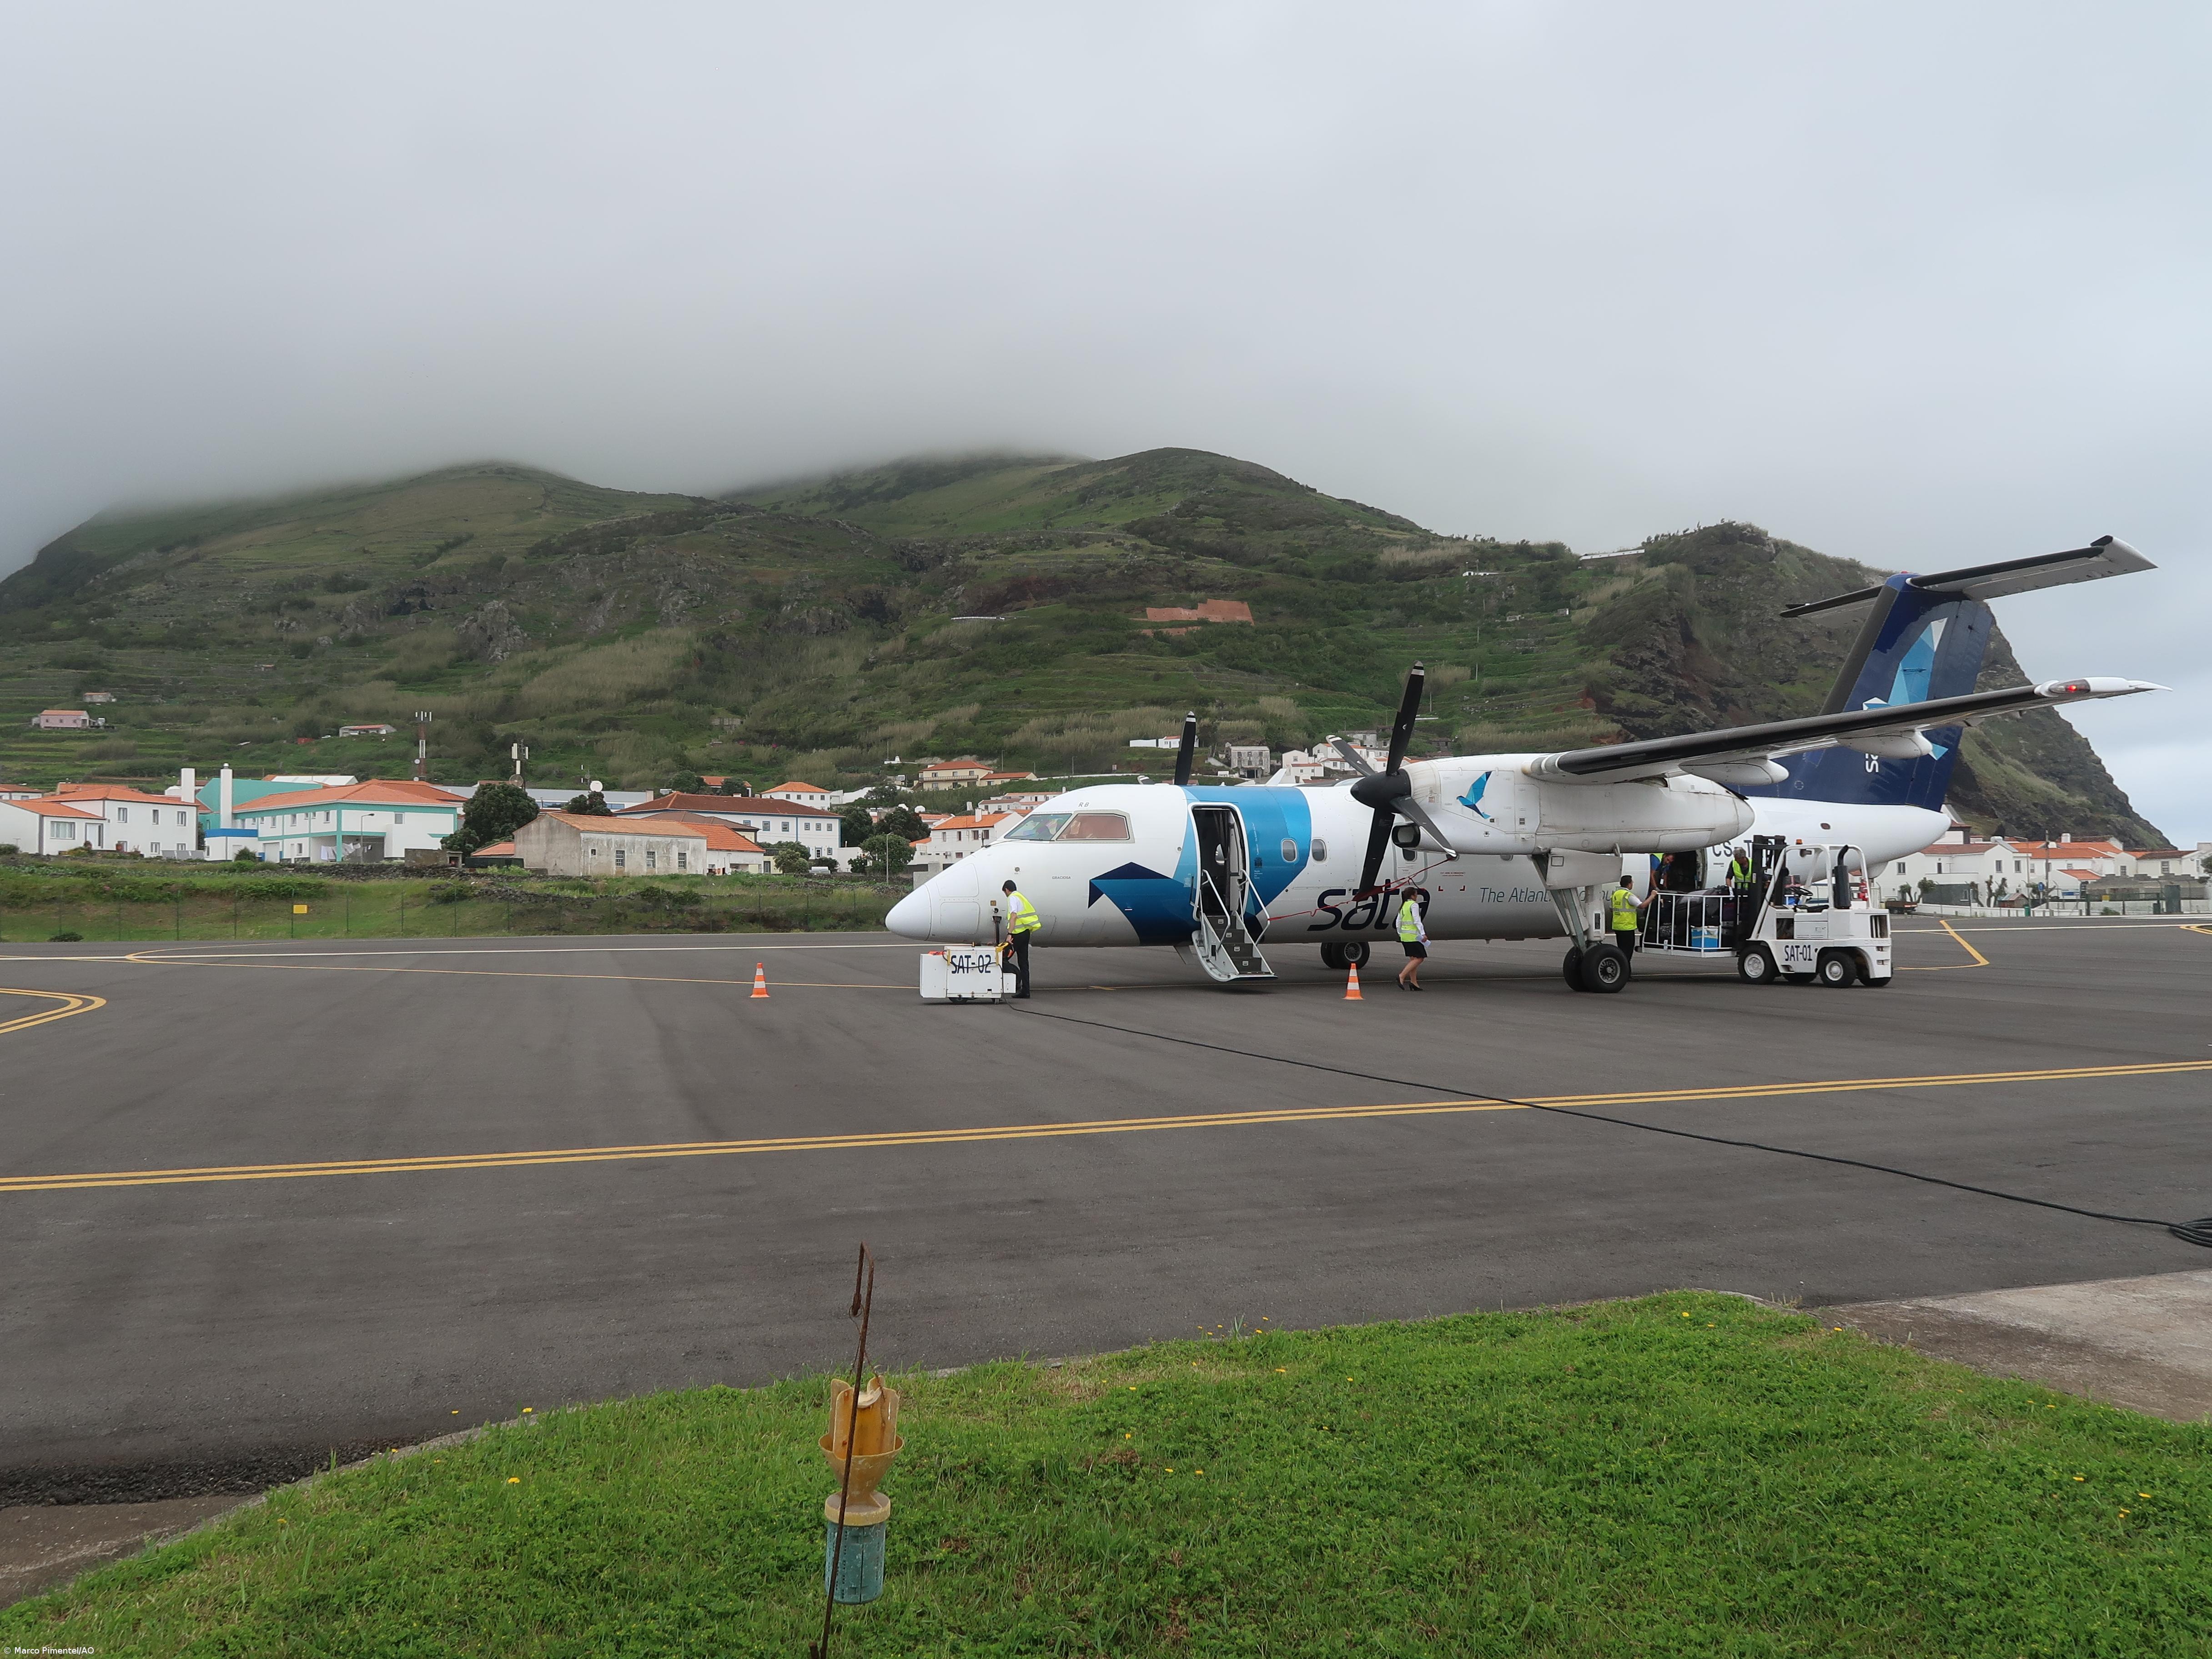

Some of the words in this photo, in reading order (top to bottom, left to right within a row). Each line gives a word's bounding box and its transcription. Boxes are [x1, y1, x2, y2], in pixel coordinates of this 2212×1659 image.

[1480, 887, 1504, 903] The
[1508, 887, 1548, 902] Atlant
[1785, 945, 1812, 961] SAT-01
[951, 955, 991, 974] SAT-02
